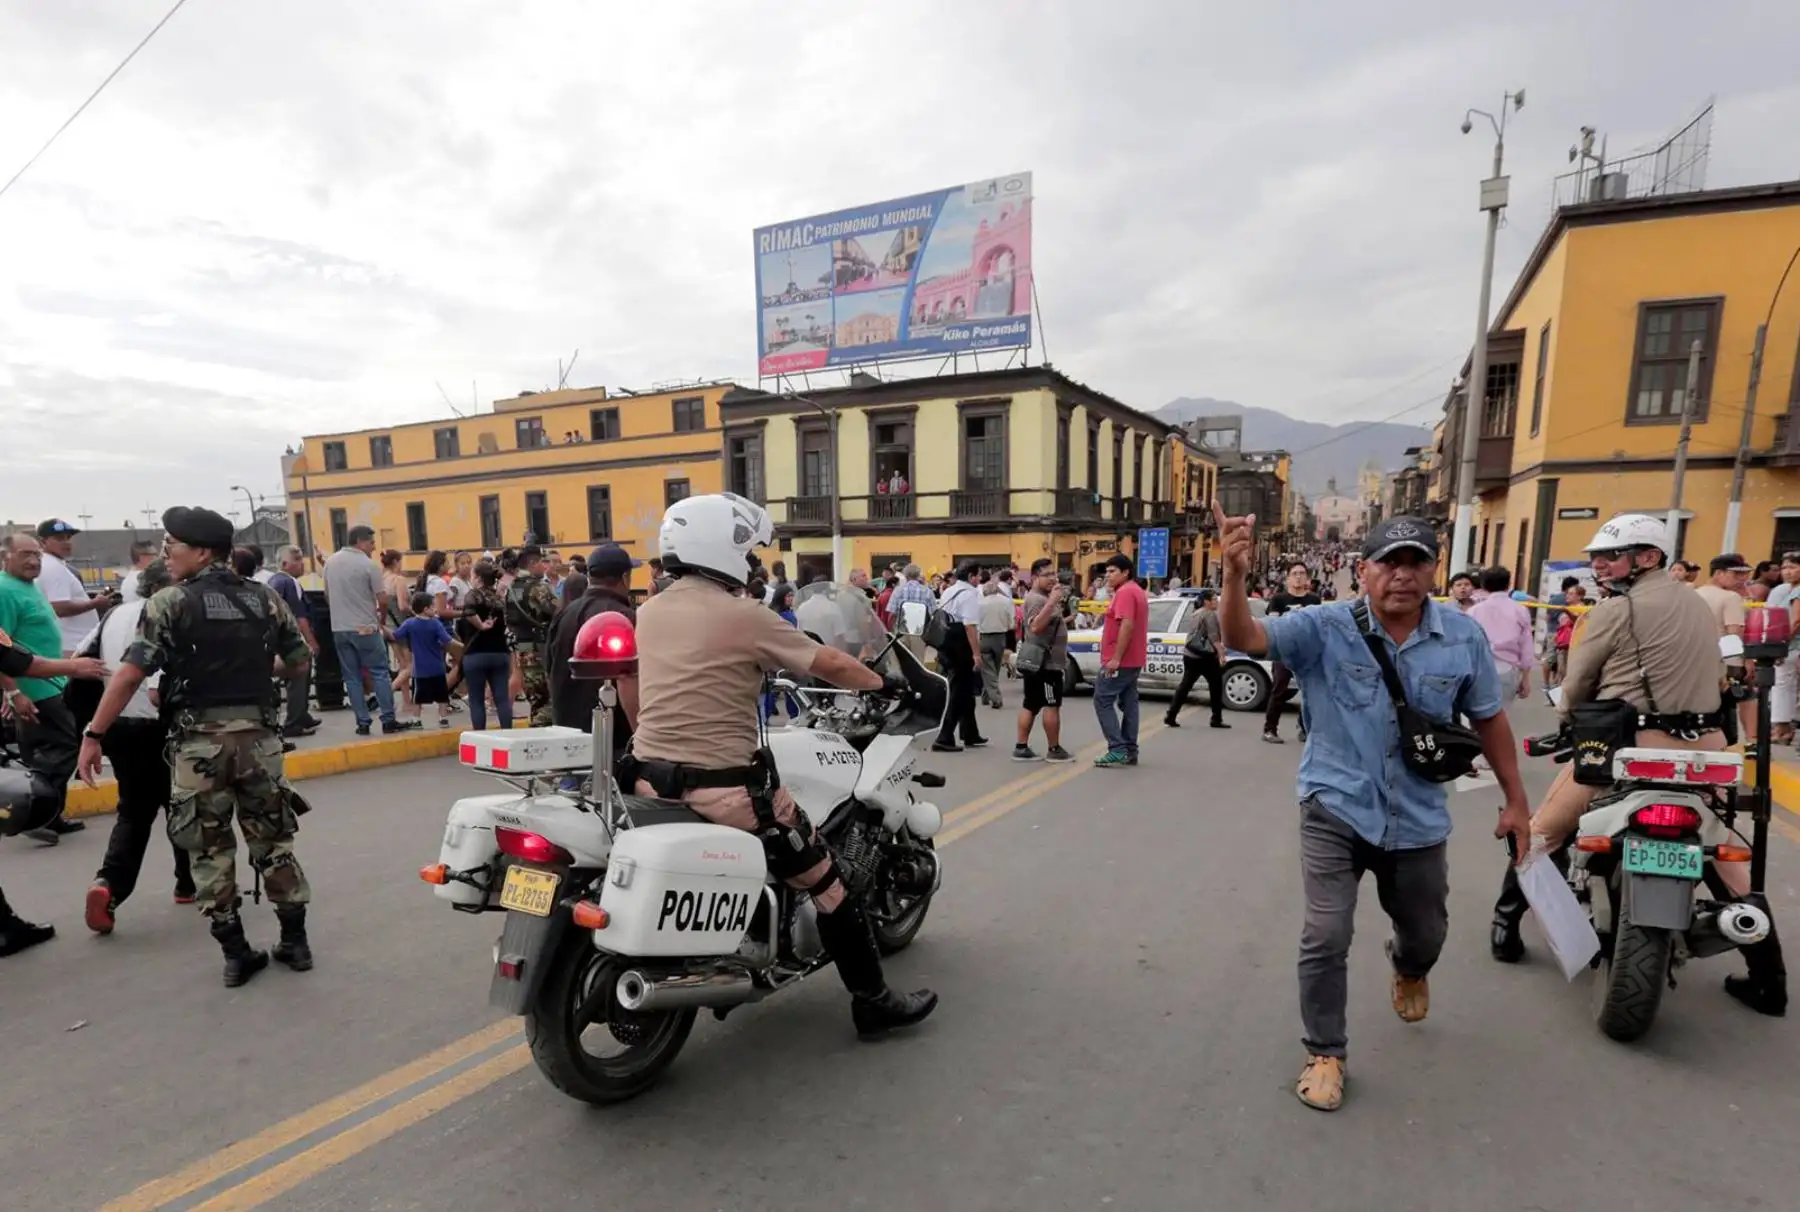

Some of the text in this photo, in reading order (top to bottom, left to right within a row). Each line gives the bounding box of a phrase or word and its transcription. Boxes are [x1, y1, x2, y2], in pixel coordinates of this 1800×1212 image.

[814, 214, 879, 240] PATRIMONIO
[882, 204, 933, 226] MUNDIAL
[943, 320, 1027, 341] Kike Peramás
[1629, 849, 1698, 871] EP-0954
[504, 883, 550, 909] PL-12755
[657, 890, 748, 932] POLICIA
